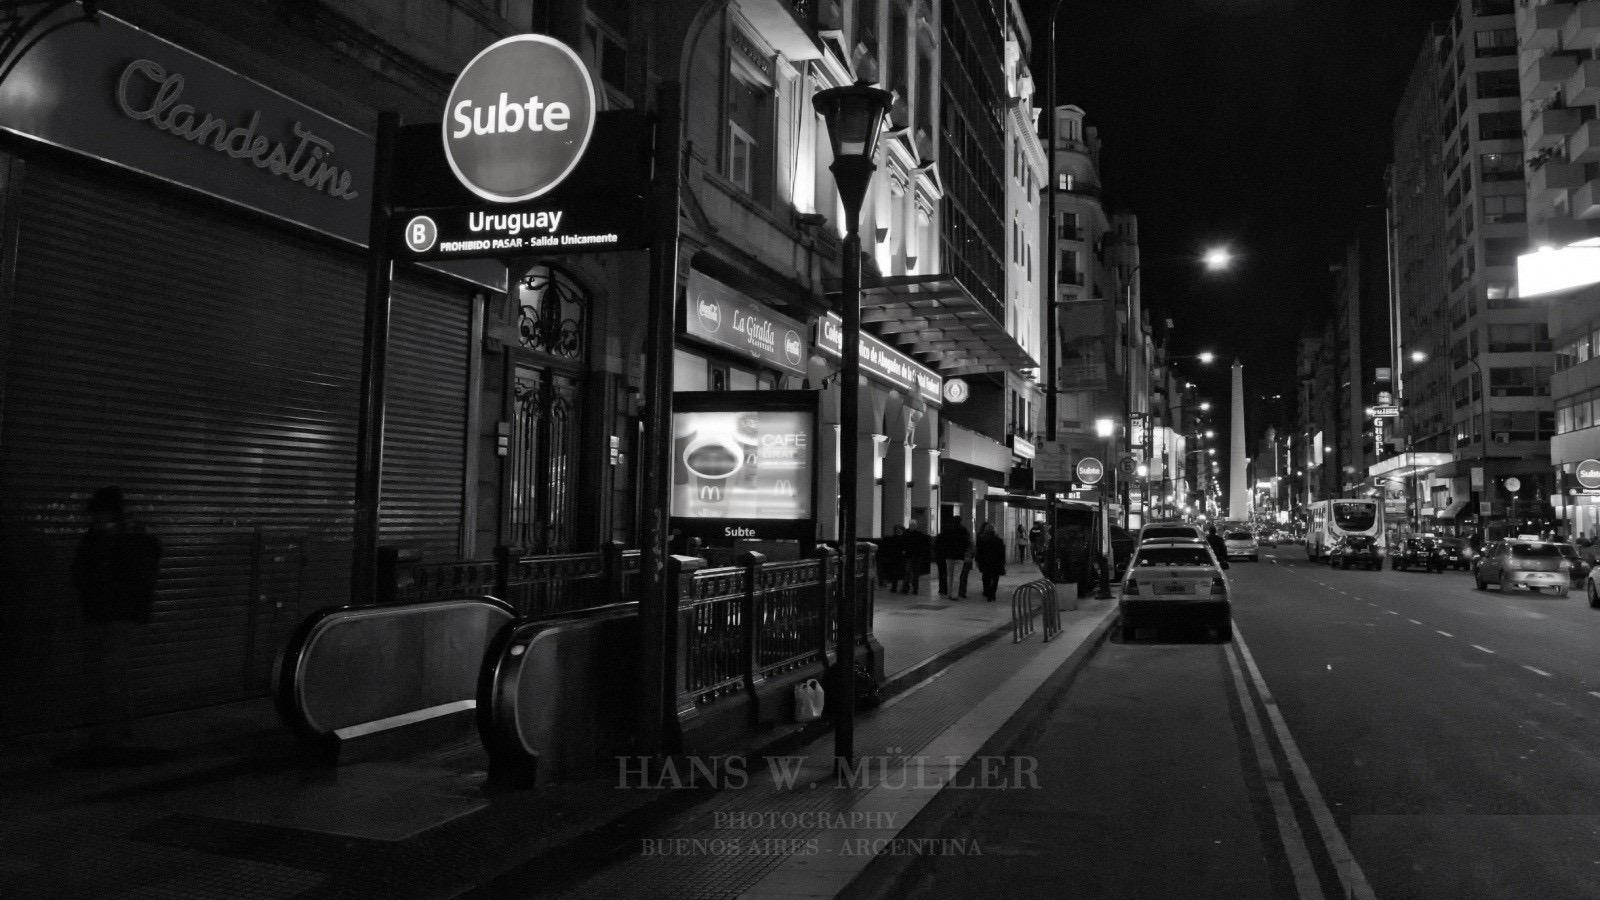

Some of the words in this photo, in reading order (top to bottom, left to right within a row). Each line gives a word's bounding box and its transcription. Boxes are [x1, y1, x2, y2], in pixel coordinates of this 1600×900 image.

[453, 92, 571, 139] Subte
[412, 223, 426, 244] B
[469, 211, 563, 234] Uruguay
[440, 239, 491, 252] PROHIBIDO
[492, 237, 523, 249] PASAR
[531, 235, 559, 247] Salida
[561, 233, 618, 245] Unicamente
[732, 309, 745, 333] La
[746, 316, 775, 346] Giralda
[724, 526, 756, 537] Subte
